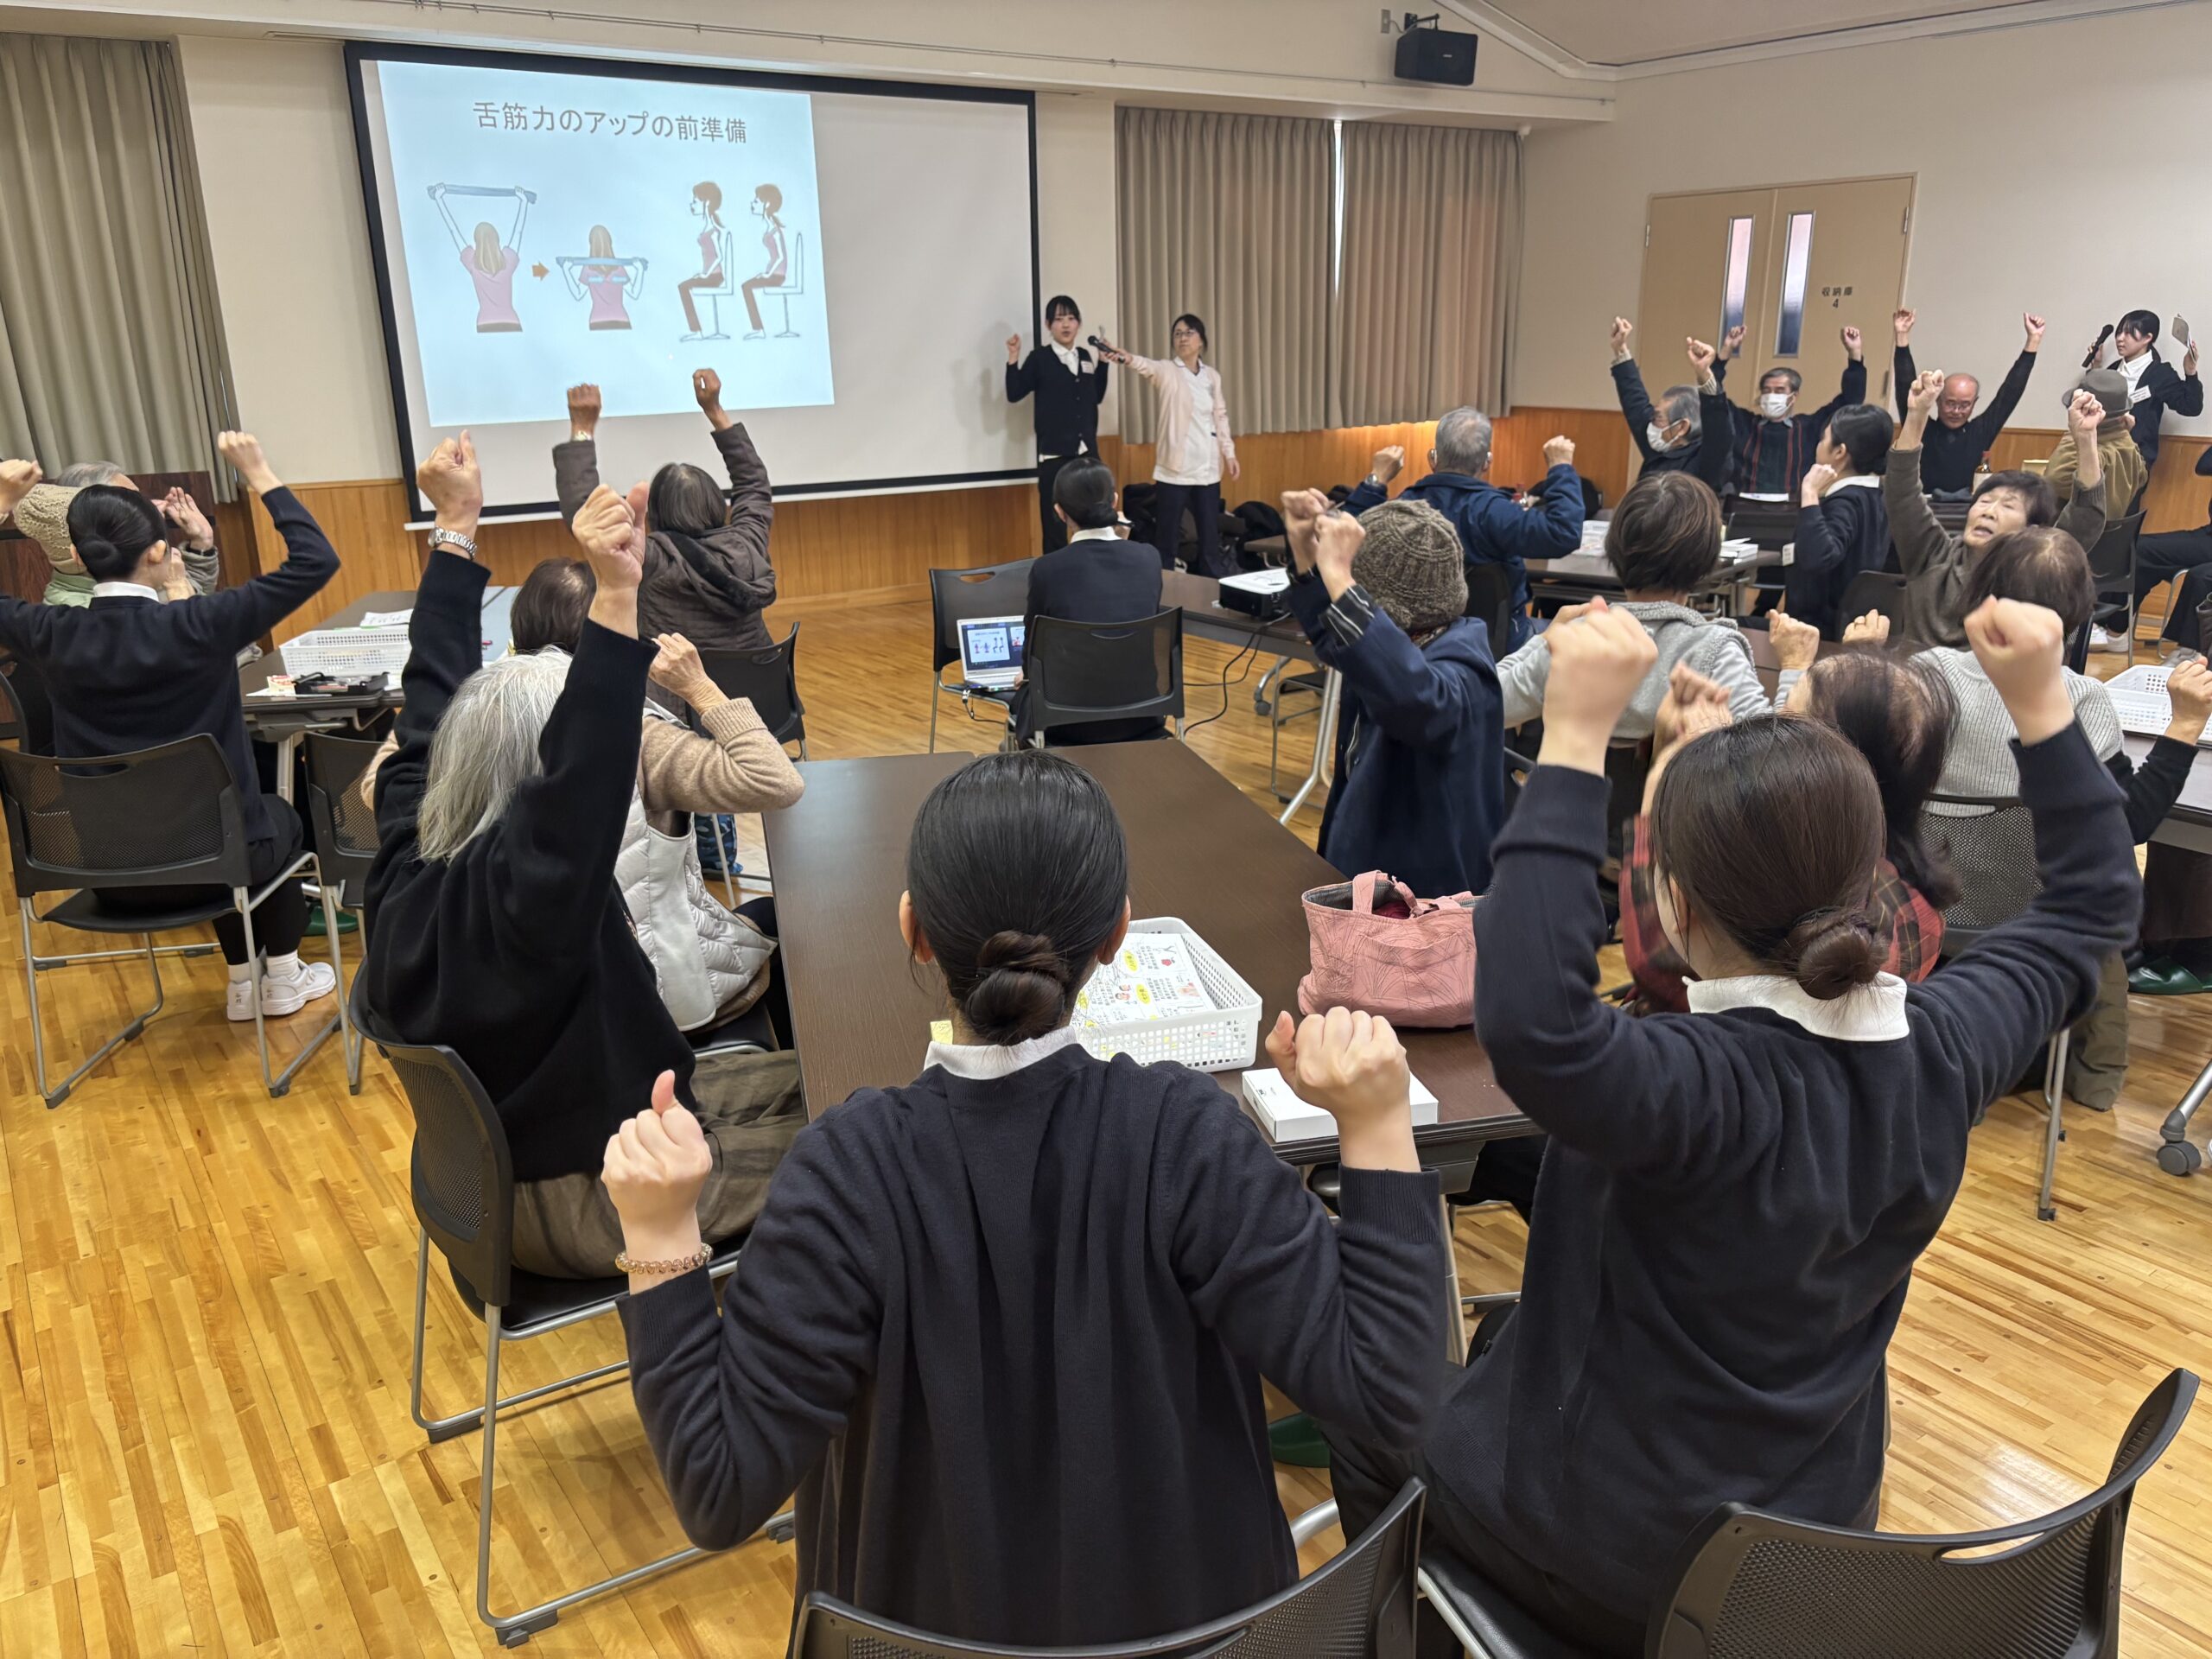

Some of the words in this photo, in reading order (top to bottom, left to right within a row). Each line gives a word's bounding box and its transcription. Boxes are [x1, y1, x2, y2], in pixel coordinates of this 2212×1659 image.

[473, 101, 747, 144] 舌筋力のアップの前準備
